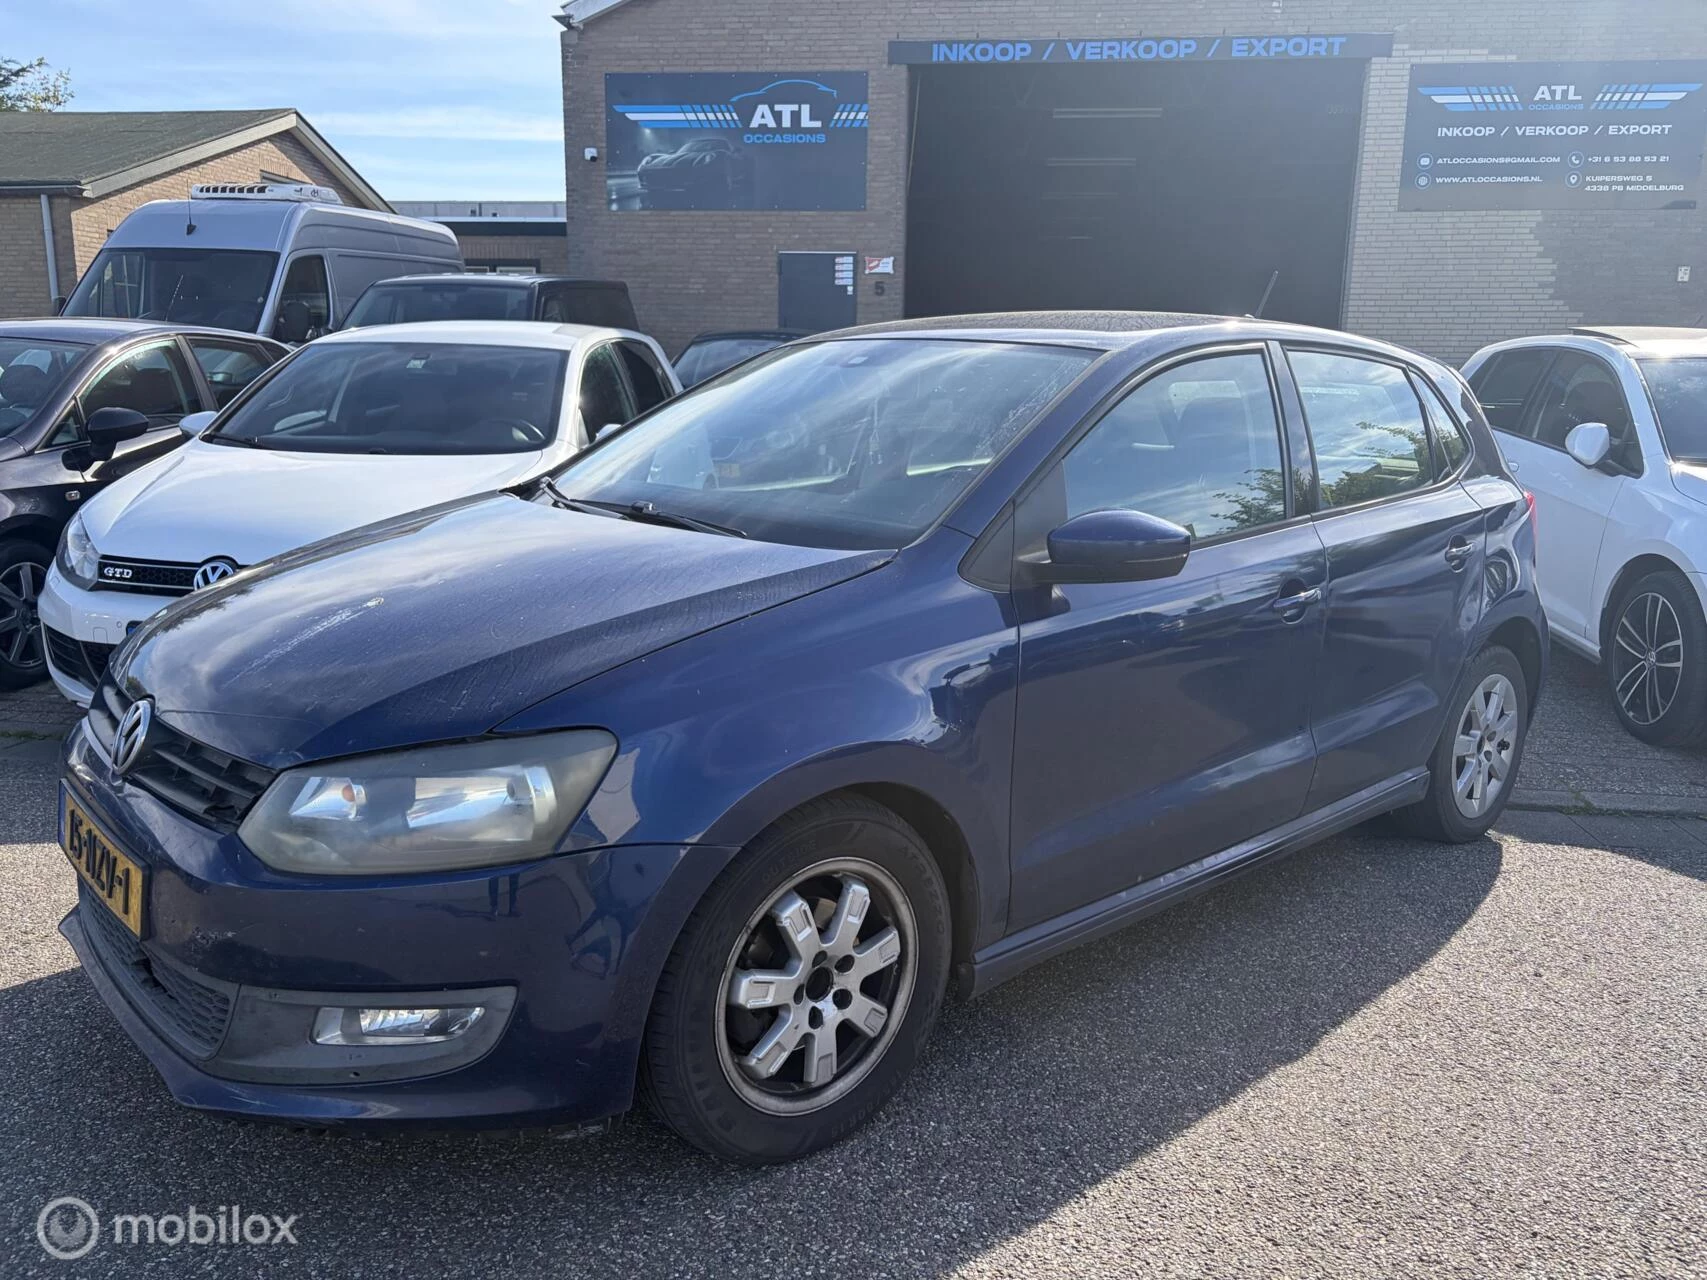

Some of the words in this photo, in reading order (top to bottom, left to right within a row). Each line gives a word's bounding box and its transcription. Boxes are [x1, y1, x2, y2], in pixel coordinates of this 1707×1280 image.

[931, 43, 1032, 62] INKOOP
[1042, 43, 1055, 60] /
[1066, 40, 1197, 60] VERKOOP
[1207, 39, 1220, 57] /
[1230, 37, 1347, 57] EXPORT
[1533, 85, 1583, 101] ATL
[1528, 103, 1584, 111] OCCASIONS
[749, 104, 822, 128] ATL
[1437, 126, 1495, 137] INKOOP
[1515, 125, 1589, 136] VERKOOP
[1608, 124, 1673, 135] EXPORT
[743, 133, 826, 144] OCCASIONS
[874, 281, 885, 296] 5
[103, 566, 133, 578] GTD
